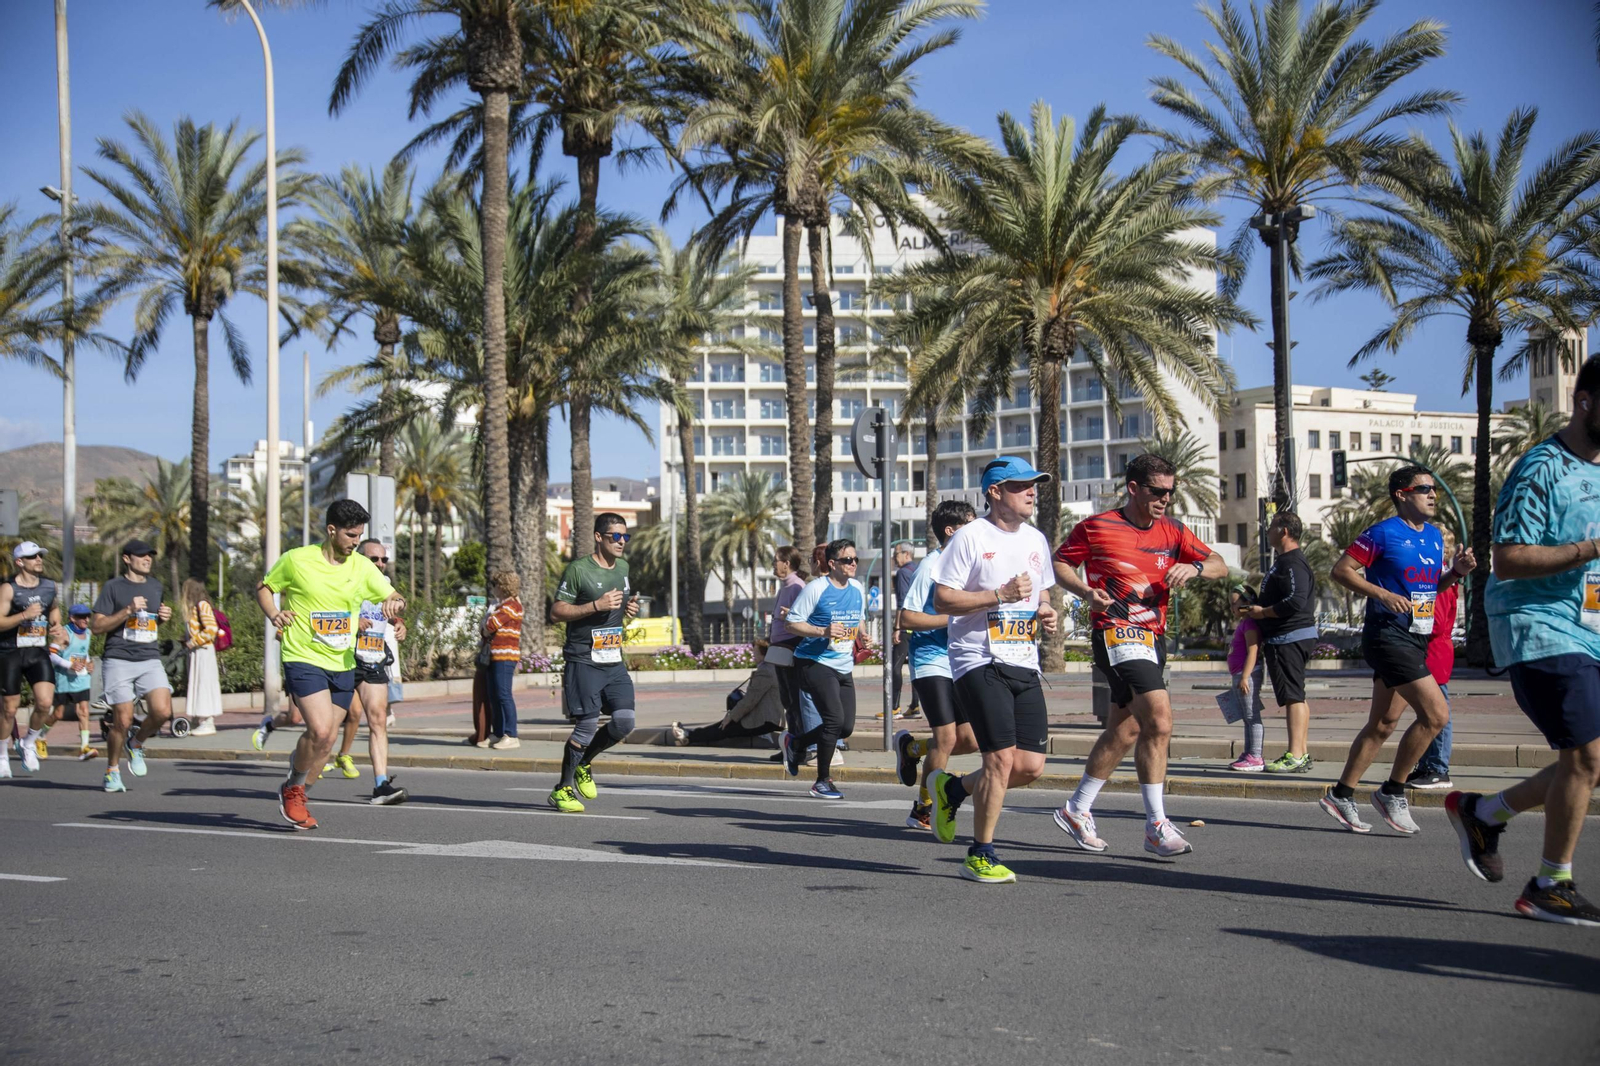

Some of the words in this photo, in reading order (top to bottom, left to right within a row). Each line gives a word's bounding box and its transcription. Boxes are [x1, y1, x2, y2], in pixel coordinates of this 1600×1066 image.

[1369, 419, 1405, 428] PALACIO
[1411, 420, 1422, 429] DE
[1429, 421, 1464, 430] JUSTICIA
[316, 619, 348, 631] 1726
[995, 620, 1034, 635] 1789
[1115, 627, 1146, 641] 806
[602, 635, 620, 646] 212
